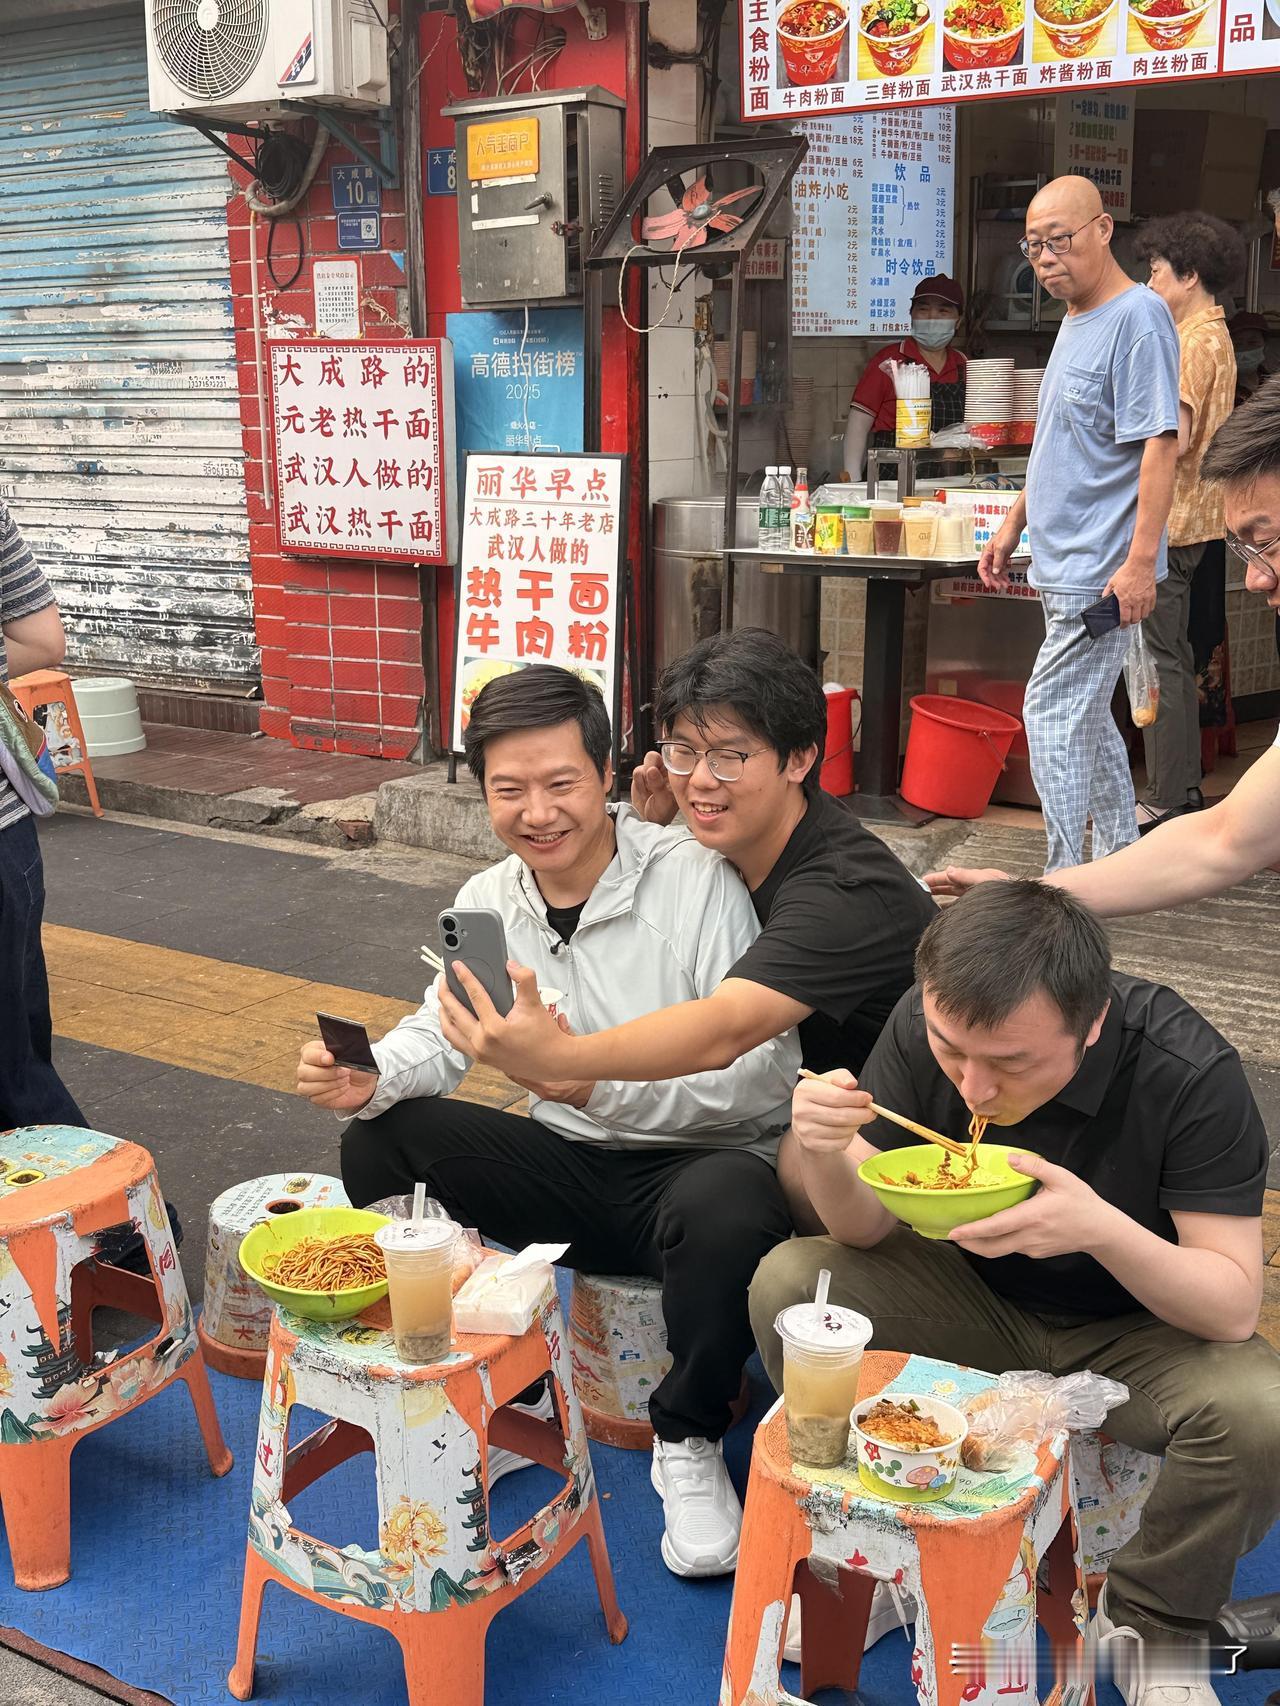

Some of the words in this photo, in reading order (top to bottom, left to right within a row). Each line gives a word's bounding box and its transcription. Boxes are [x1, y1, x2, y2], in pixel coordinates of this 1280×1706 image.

[1229, 13, 1255, 43] 品
[748, 0, 770, 112] 主食粉面
[1132, 52, 1209, 77] 肉丝粉面
[940, 68, 1029, 92] 武汉热干面
[1039, 60, 1113, 83] 炸酱粉面
[782, 86, 845, 109] 牛肉粉面
[864, 79, 931, 101] 三鲜粉面
[802, 132, 848, 144] 肉面/粉/豆丝
[336, 167, 373, 181] 大成路
[894, 163, 931, 183] 饮品
[346, 180, 364, 204] 10
[794, 180, 849, 200] 油炸小吃
[847, 206, 857, 214] 2元
[871, 226, 885, 236] 汽水
[847, 253, 857, 262] 2元
[847, 265, 857, 273] 1元
[886, 258, 936, 276] 时令饮品
[847, 277, 857, 286] 1元
[847, 289, 857, 297] 2元
[847, 300, 857, 309] 3元
[278, 353, 430, 390] 大成路的
[470, 350, 576, 378] 高德扫街榜
[505, 384, 541, 399] 2025
[280, 405, 431, 440] 元老热干面
[505, 434, 542, 447] 丽华早点
[284, 452, 433, 492] 武汉人做的
[476, 466, 609, 503] 丽华早点
[286, 501, 434, 543] 武汉热干面
[469, 506, 615, 534] 大成路三十年老店
[487, 534, 590, 565] 武汉人做的
[466, 566, 609, 615] 热干面
[466, 612, 610, 662] 牛肉粉
